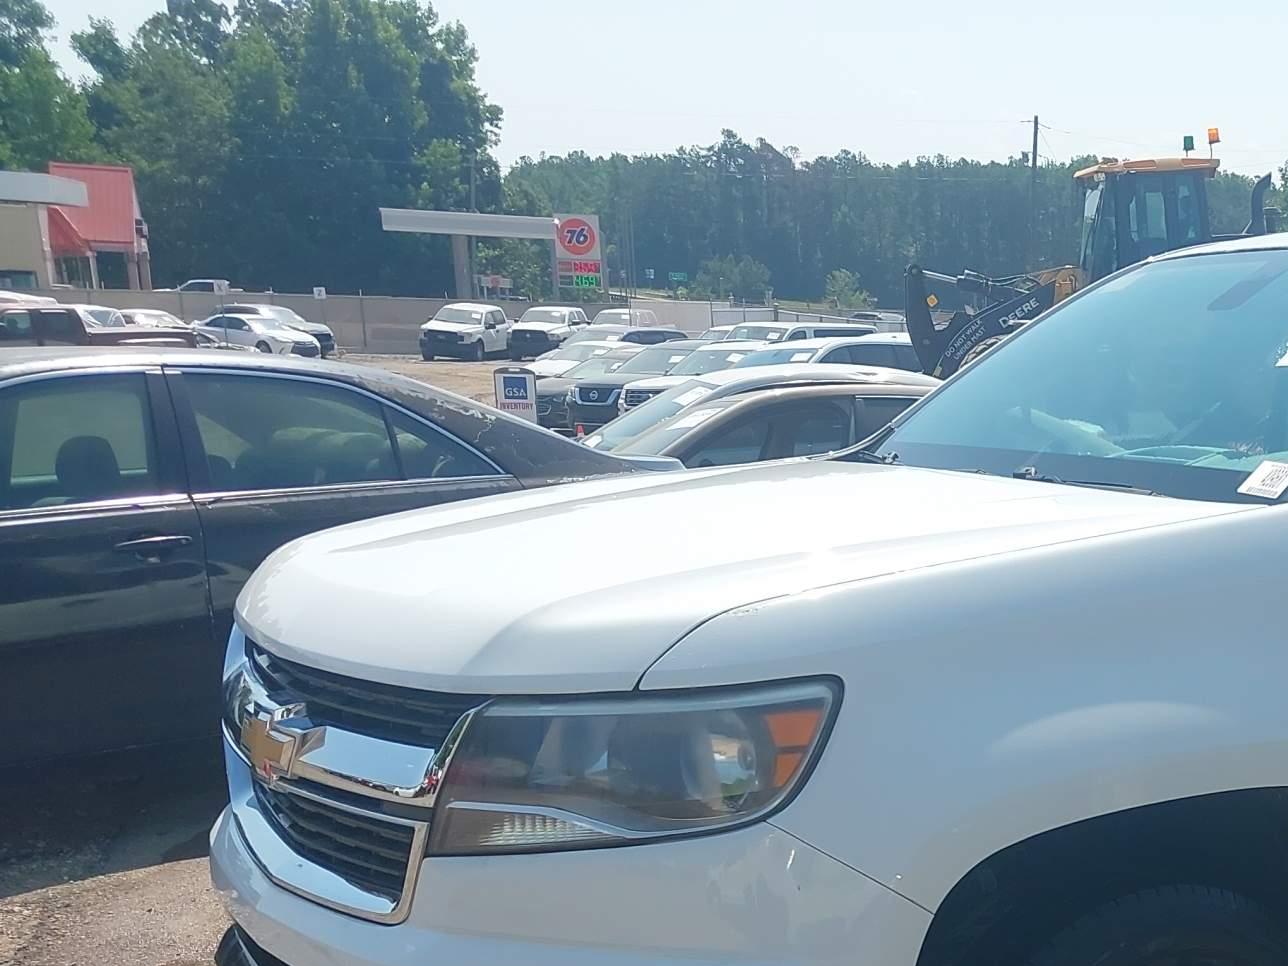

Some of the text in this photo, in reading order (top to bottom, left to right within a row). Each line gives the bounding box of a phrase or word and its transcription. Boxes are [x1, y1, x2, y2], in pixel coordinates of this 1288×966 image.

[564, 226, 589, 246] 76
[999, 297, 1040, 328] DEERE
[945, 319, 983, 357] DO NOT WALK
[953, 326, 985, 360] UNDER MAST
[505, 387, 527, 398] GSA
[500, 402, 534, 410] INVENTORY
